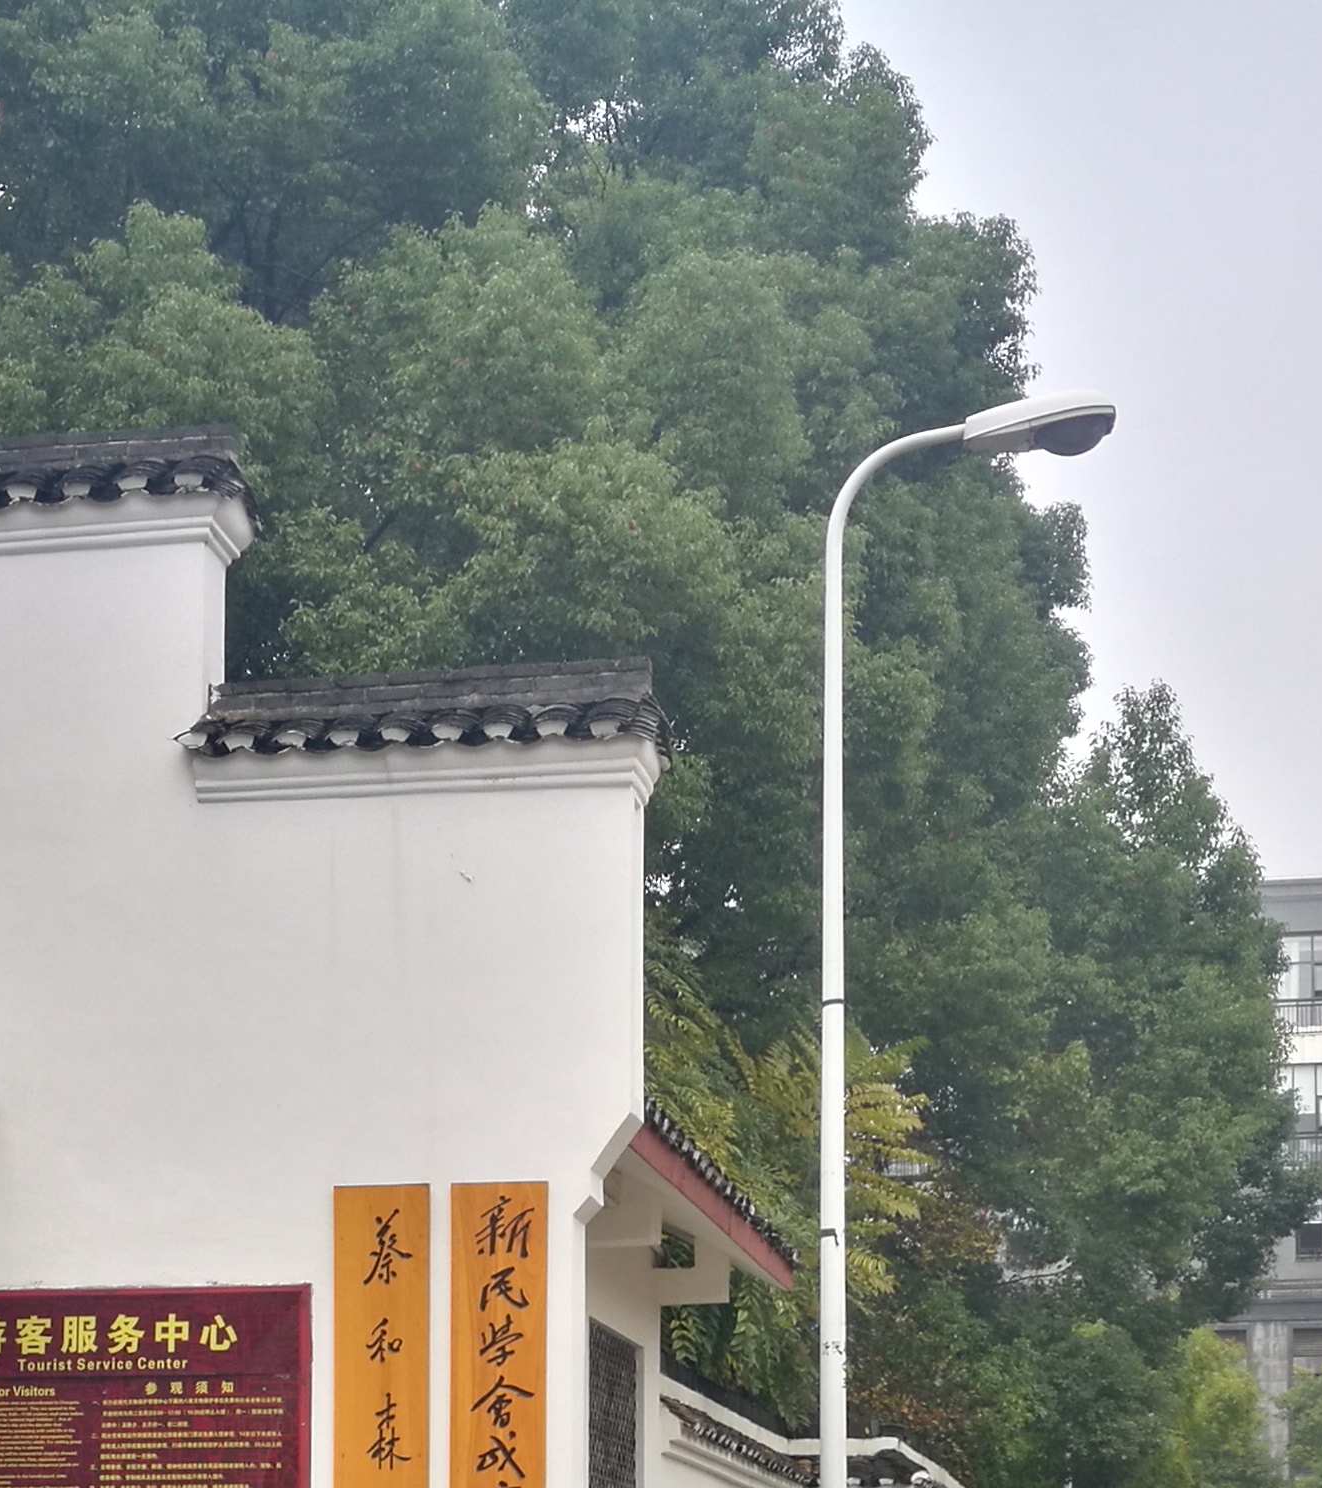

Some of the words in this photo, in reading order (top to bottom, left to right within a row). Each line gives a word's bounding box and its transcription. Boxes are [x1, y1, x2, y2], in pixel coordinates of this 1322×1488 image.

[17, 1358, 72, 1372] Tourist
[77, 1358, 133, 1371] Service
[137, 1356, 188, 1370] Center
[13, 1385, 56, 1397] Visitors
